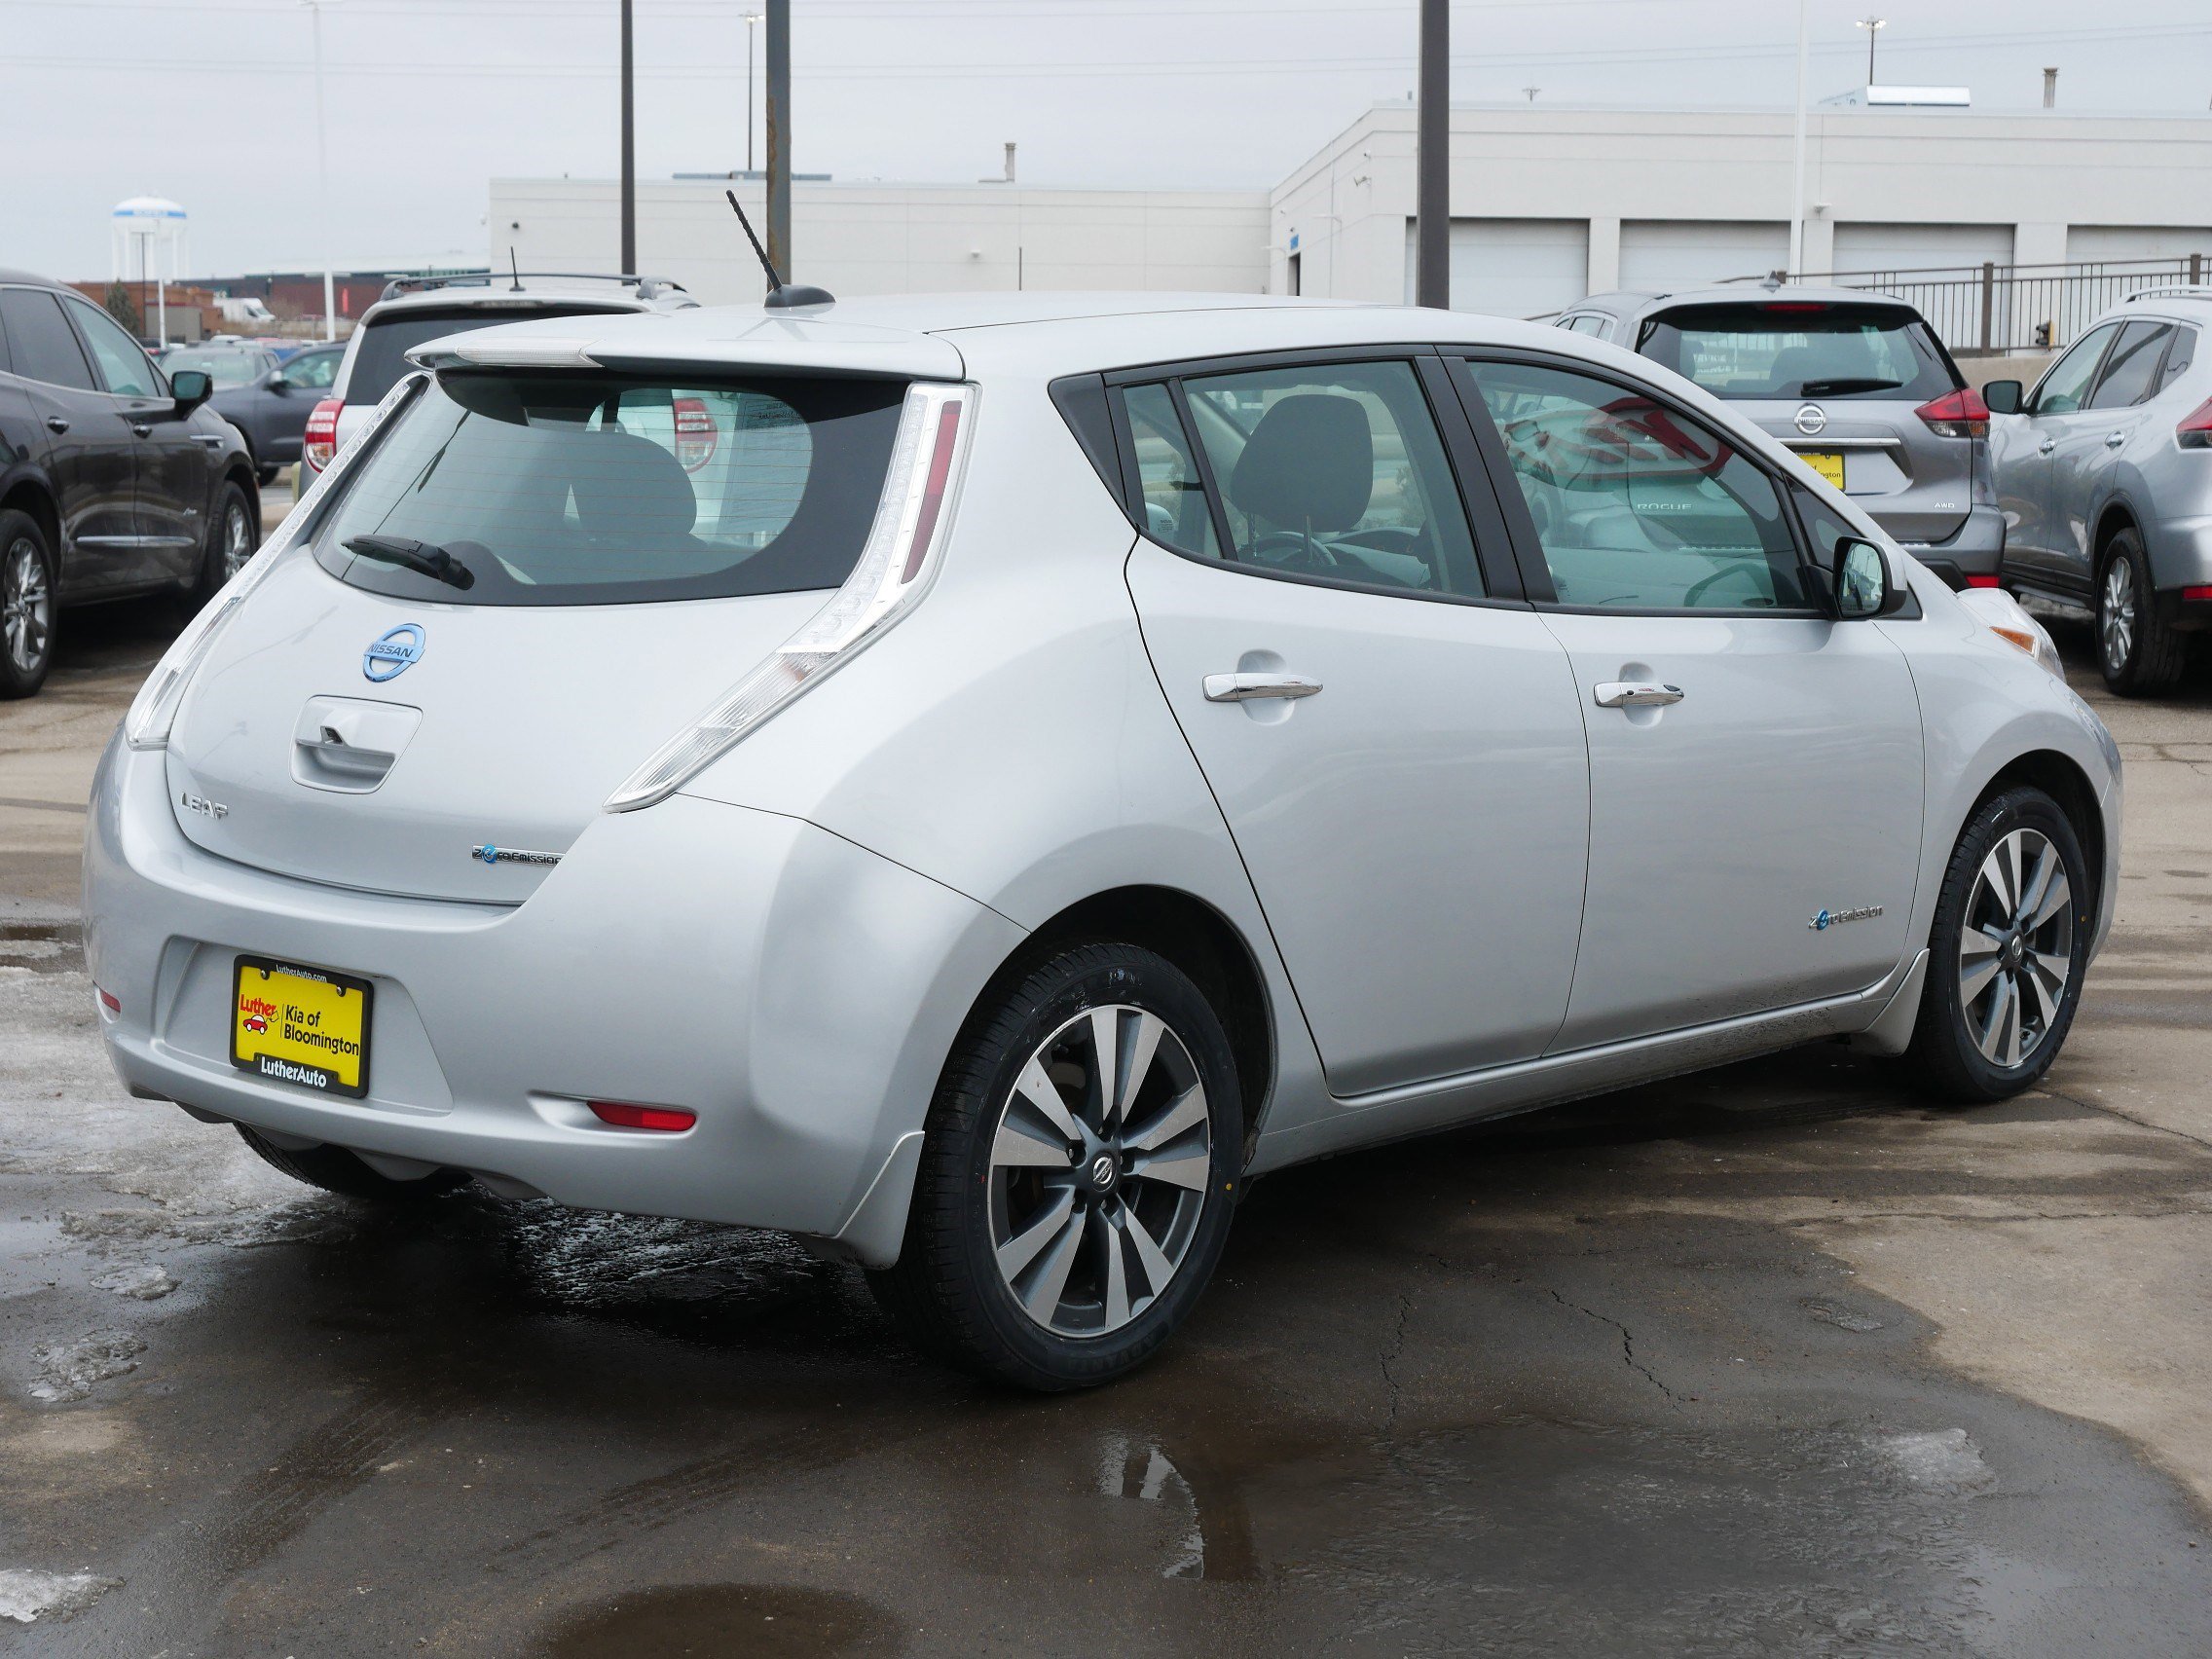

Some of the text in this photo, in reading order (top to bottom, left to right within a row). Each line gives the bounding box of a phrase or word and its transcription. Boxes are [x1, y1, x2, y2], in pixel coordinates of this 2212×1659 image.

[369, 643, 414, 658] NISSAN
[181, 791, 228, 820] LEAF
[276, 964, 328, 983] LutherAuto.com
[240, 994, 277, 1017] Luther
[285, 1005, 321, 1028] Kia of
[283, 1024, 359, 1056] Bloomington
[261, 1056, 327, 1088] LutherAuto
